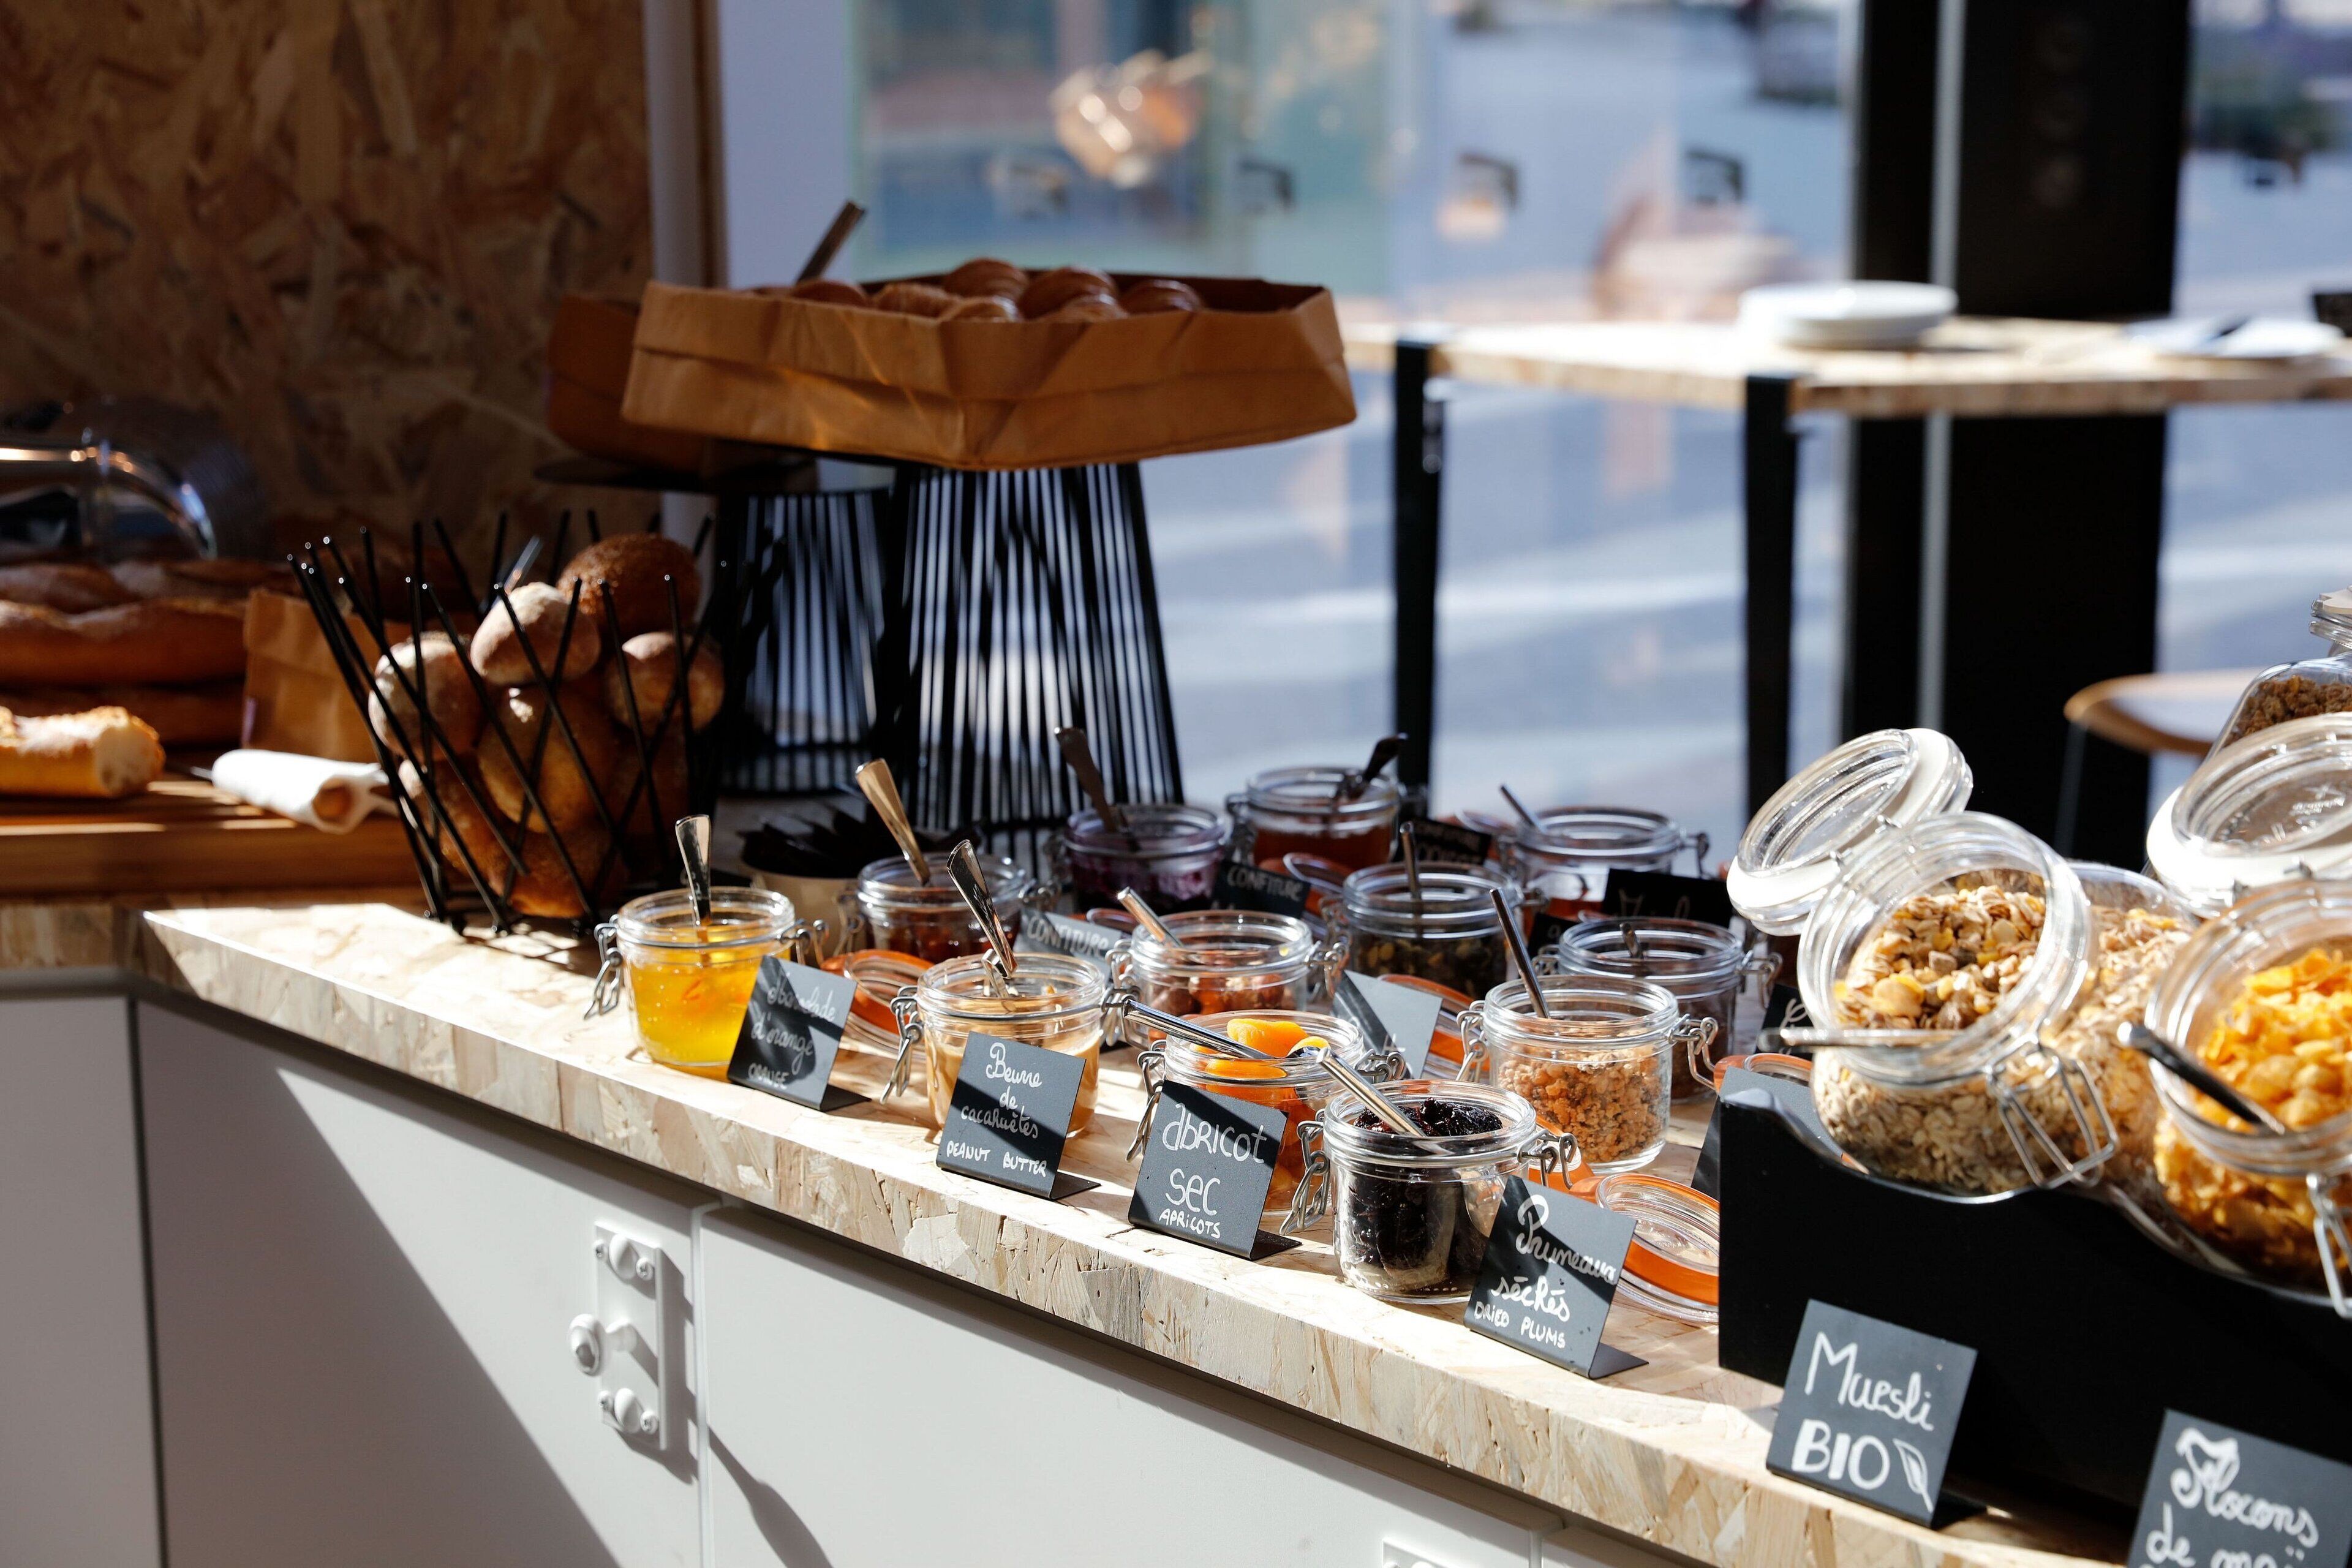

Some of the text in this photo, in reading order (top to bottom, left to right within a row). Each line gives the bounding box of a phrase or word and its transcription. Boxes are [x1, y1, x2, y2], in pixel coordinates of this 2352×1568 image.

[986, 1042, 1042, 1088] Beurre
[999, 1085, 1018, 1110] de
[946, 1140, 1047, 1178] PEANUT BUTTER
[1515, 1194, 1617, 1285] Pruneaux
[1491, 1275, 1570, 1322] séchés
[1520, 1316, 1566, 1348] PLUMS
[1804, 1331, 1935, 1431] Muesli
[1791, 1418, 1891, 1491] BIO
[2170, 1427, 2320, 1548] Flocons
[2146, 1501, 2196, 1567] de
